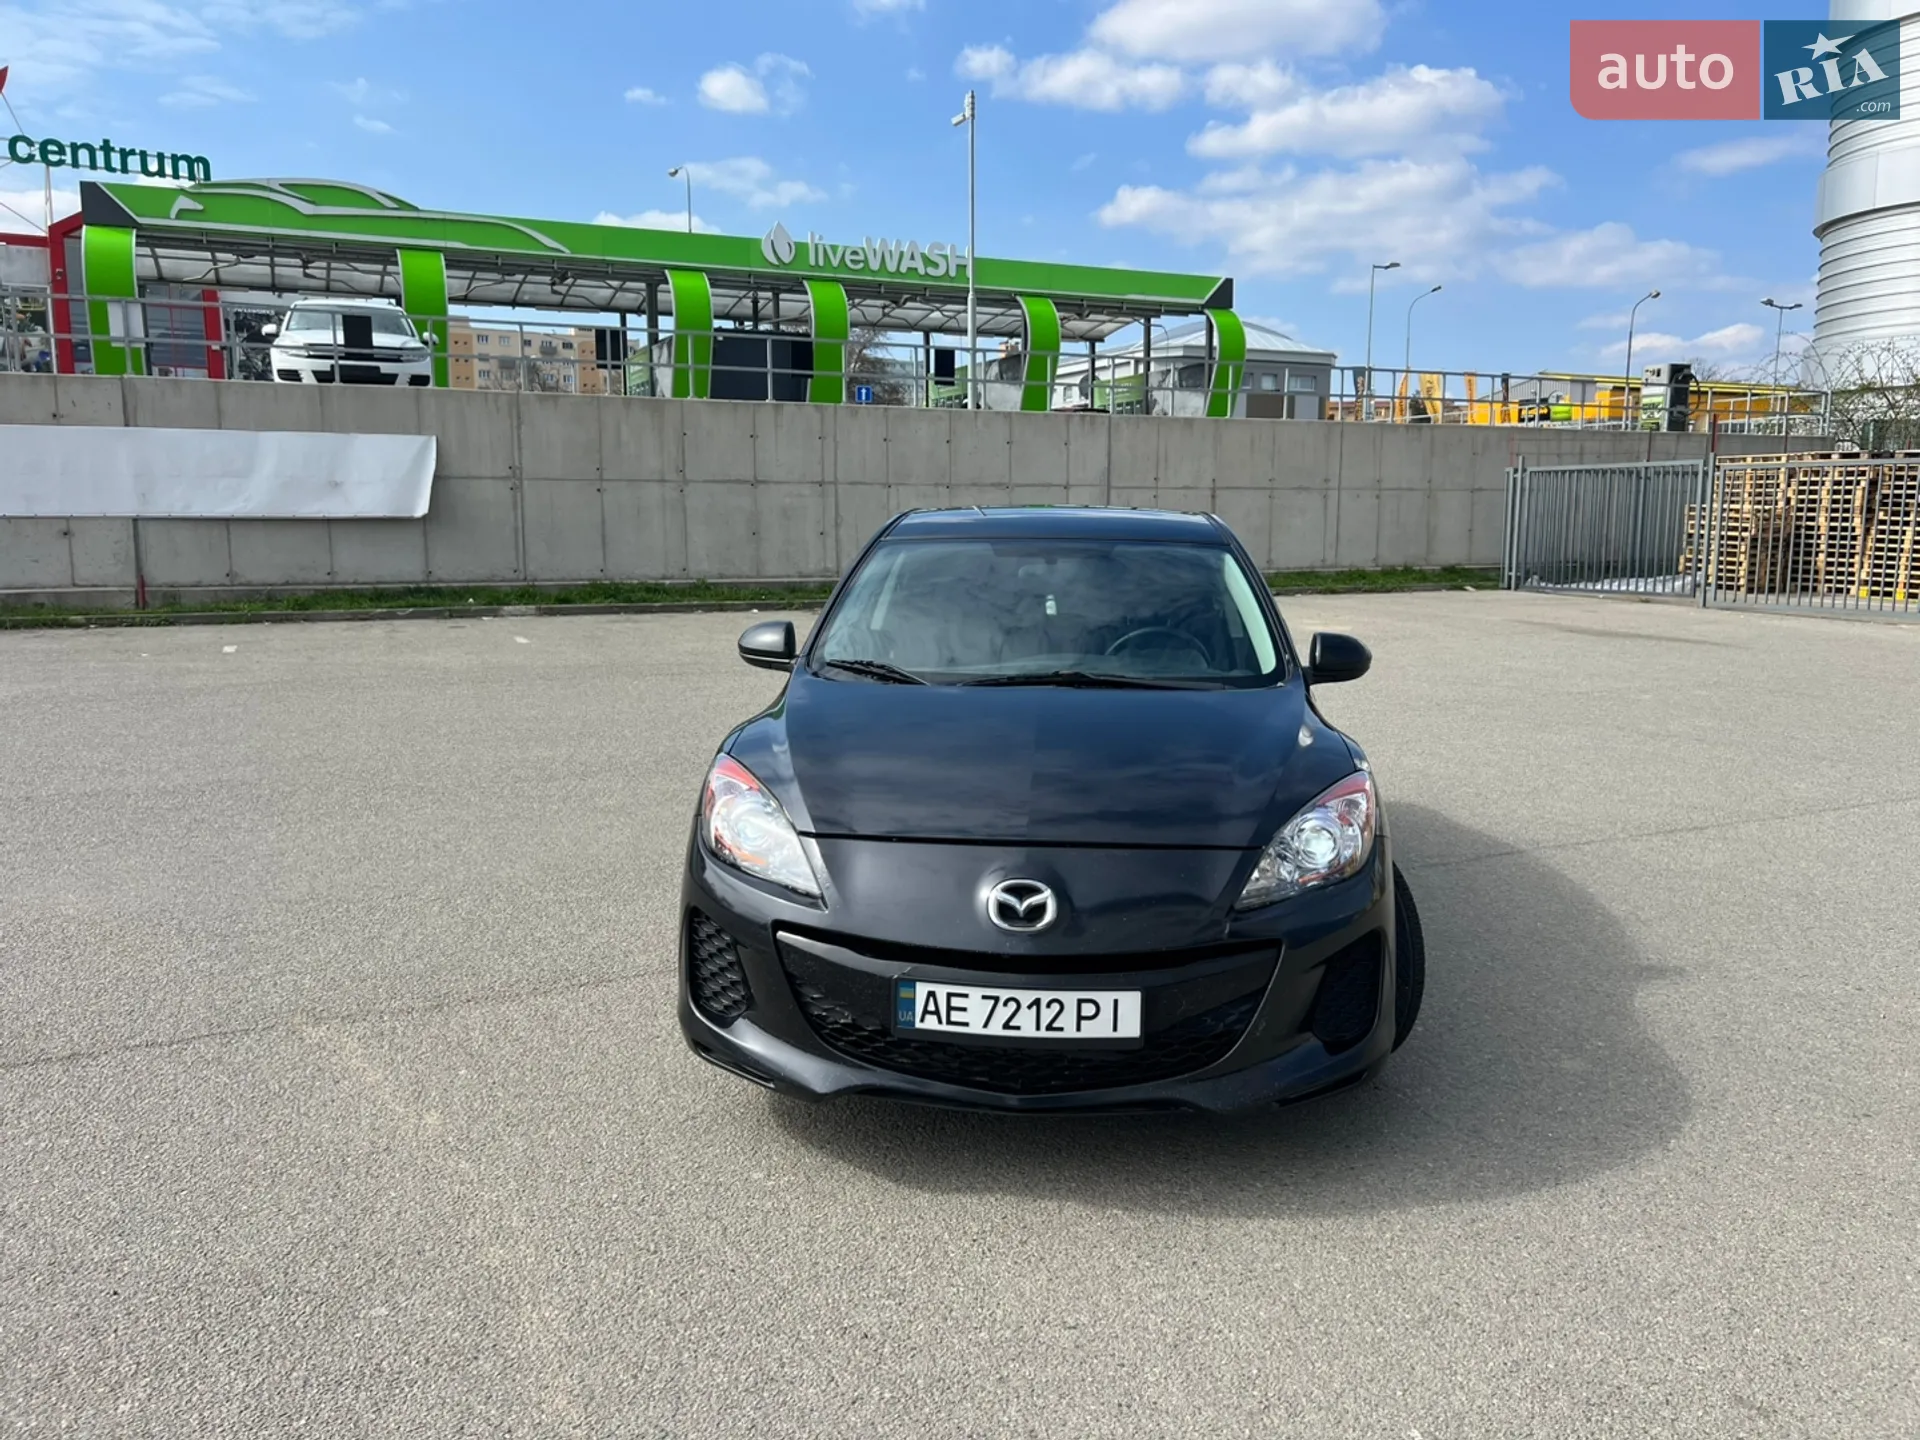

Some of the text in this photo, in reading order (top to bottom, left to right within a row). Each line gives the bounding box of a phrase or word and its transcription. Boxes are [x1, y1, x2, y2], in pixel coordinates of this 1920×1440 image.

[8, 134, 212, 182] centrum
[807, 230, 972, 278] liveWASH
[898, 1010, 914, 1022] UA
[919, 990, 1119, 1033] AE 7212 PI
